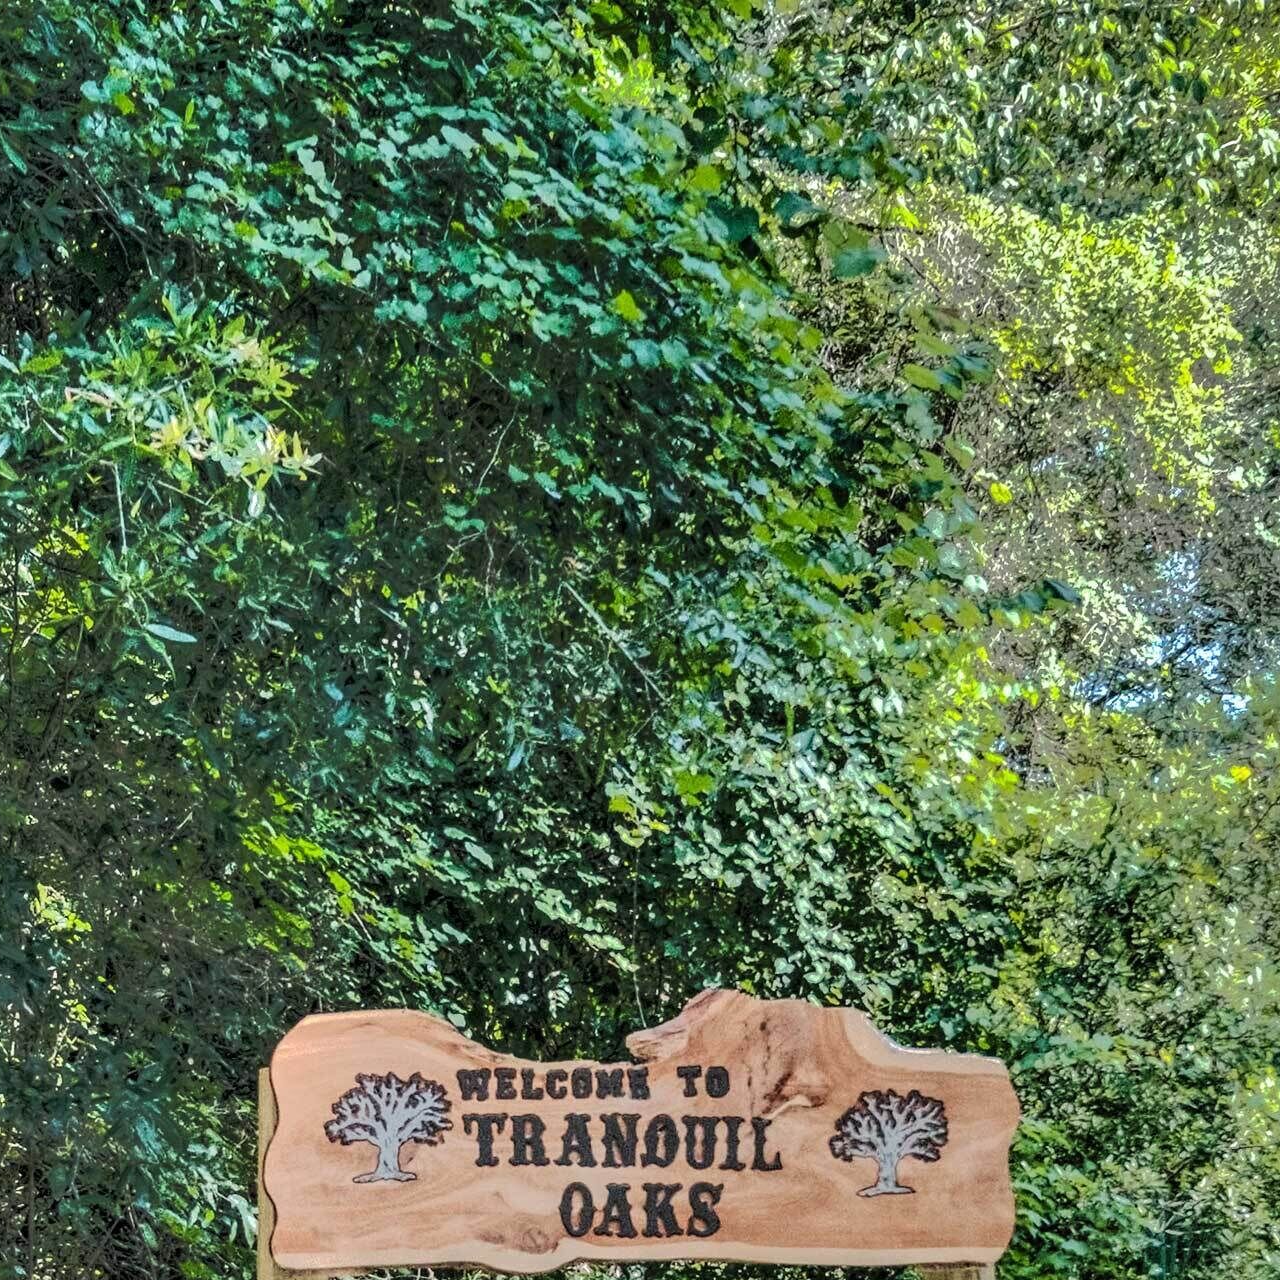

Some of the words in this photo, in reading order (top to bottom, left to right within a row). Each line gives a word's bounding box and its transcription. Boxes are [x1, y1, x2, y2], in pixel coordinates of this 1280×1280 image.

[456, 1066, 650, 1100] WELCOME
[677, 1065, 730, 1098] TO
[463, 1112, 783, 1171] TRANQUIL
[559, 1181, 724, 1239] OAKS
